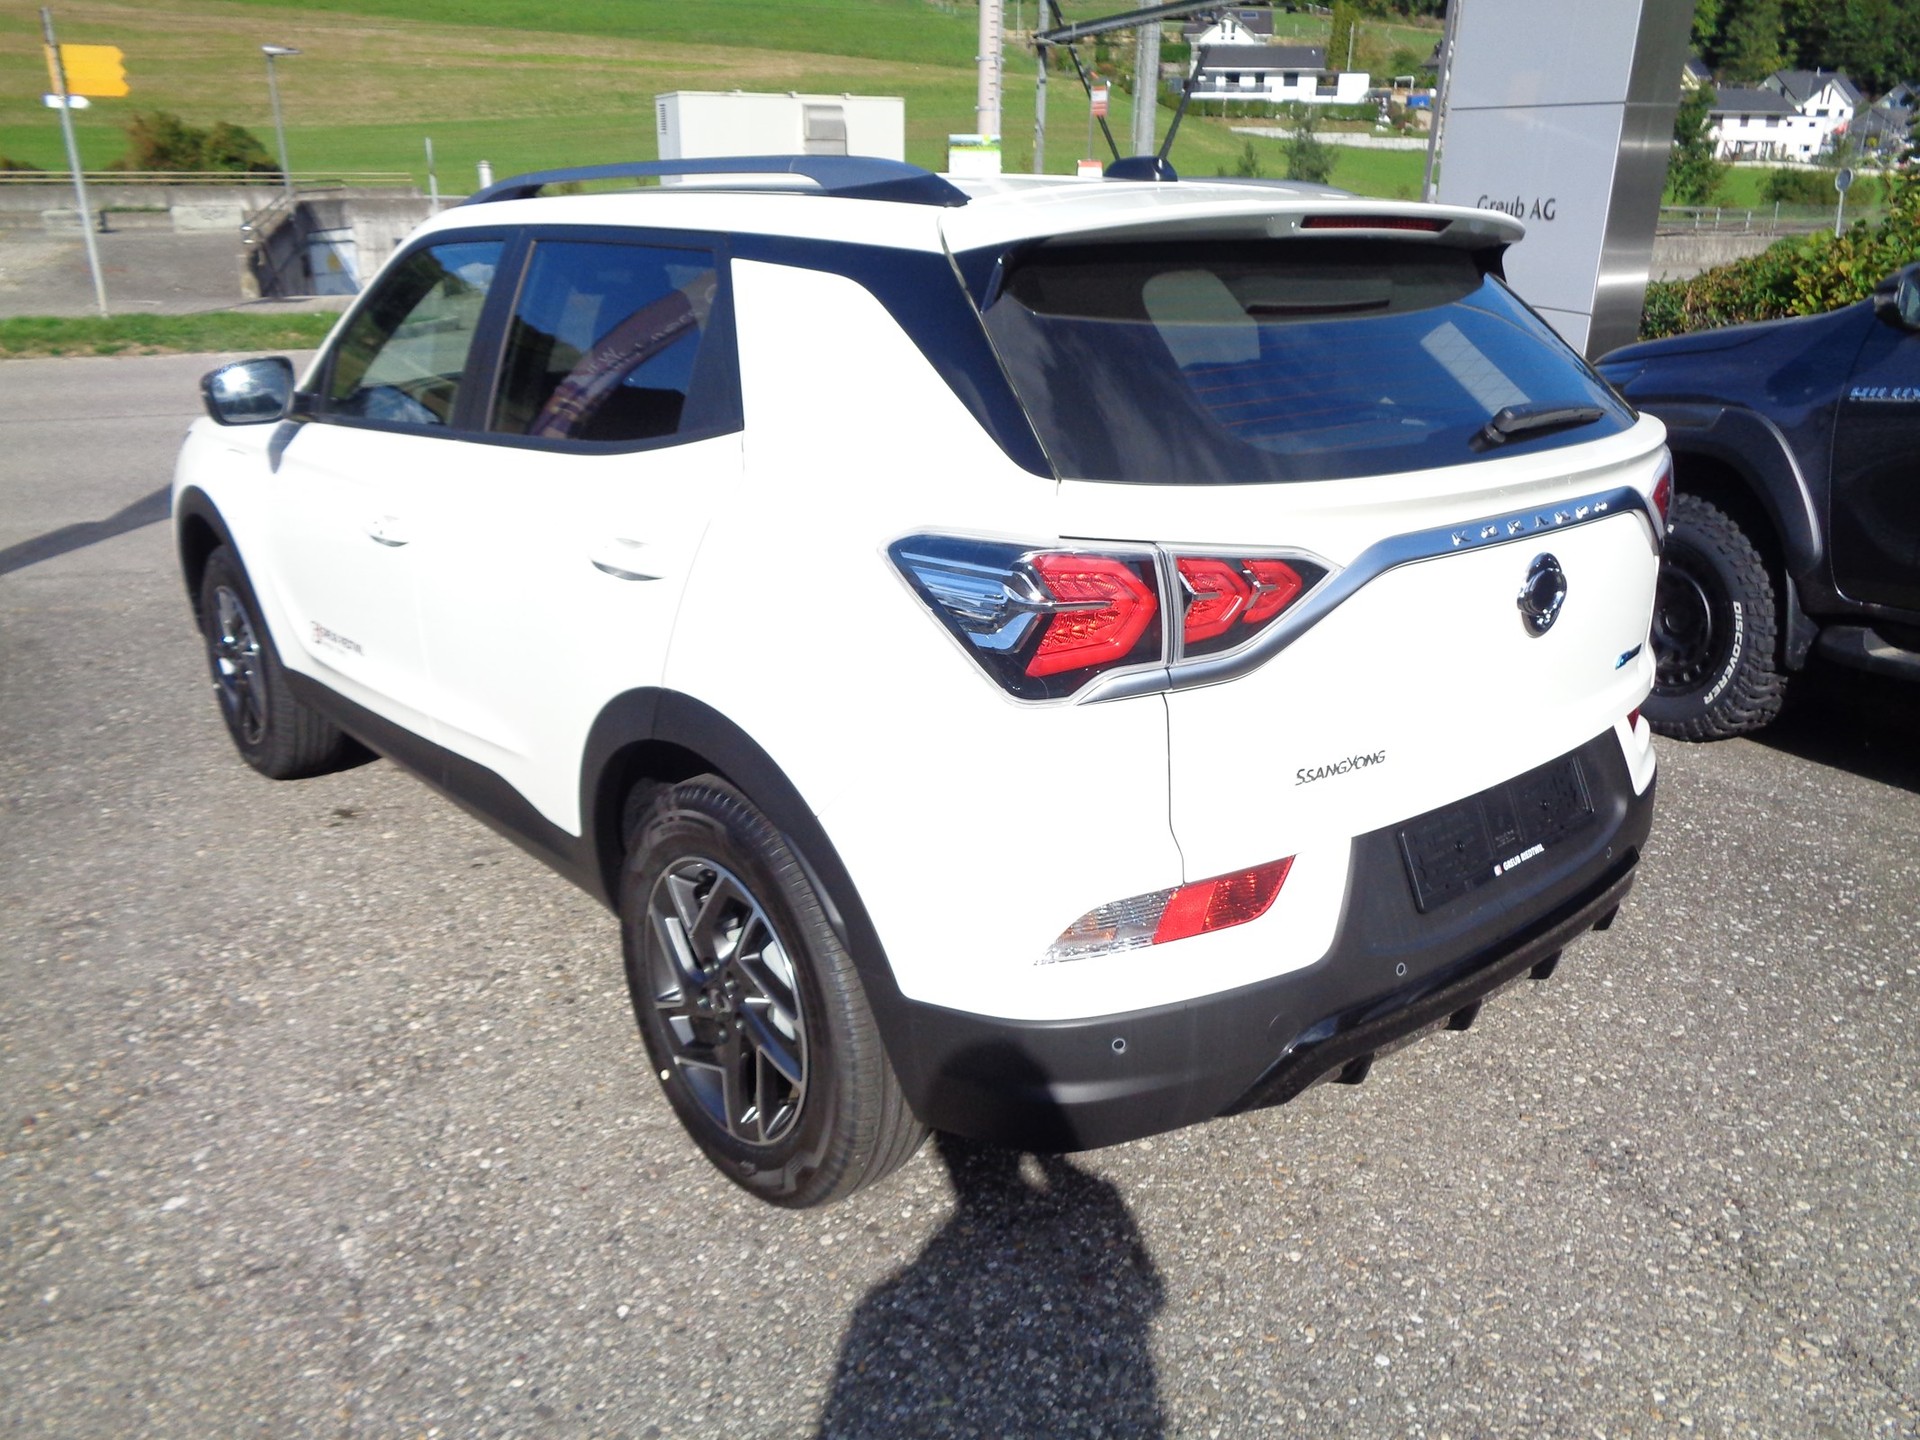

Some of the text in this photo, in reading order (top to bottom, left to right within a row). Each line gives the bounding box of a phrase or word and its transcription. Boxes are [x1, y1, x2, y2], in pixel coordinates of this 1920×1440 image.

[1529, 197, 1556, 221] AG
[1703, 600, 1744, 705] DISCOVERER
[1294, 749, 1386, 786] SSANGYONG
[1502, 854, 1521, 871] GREUB
